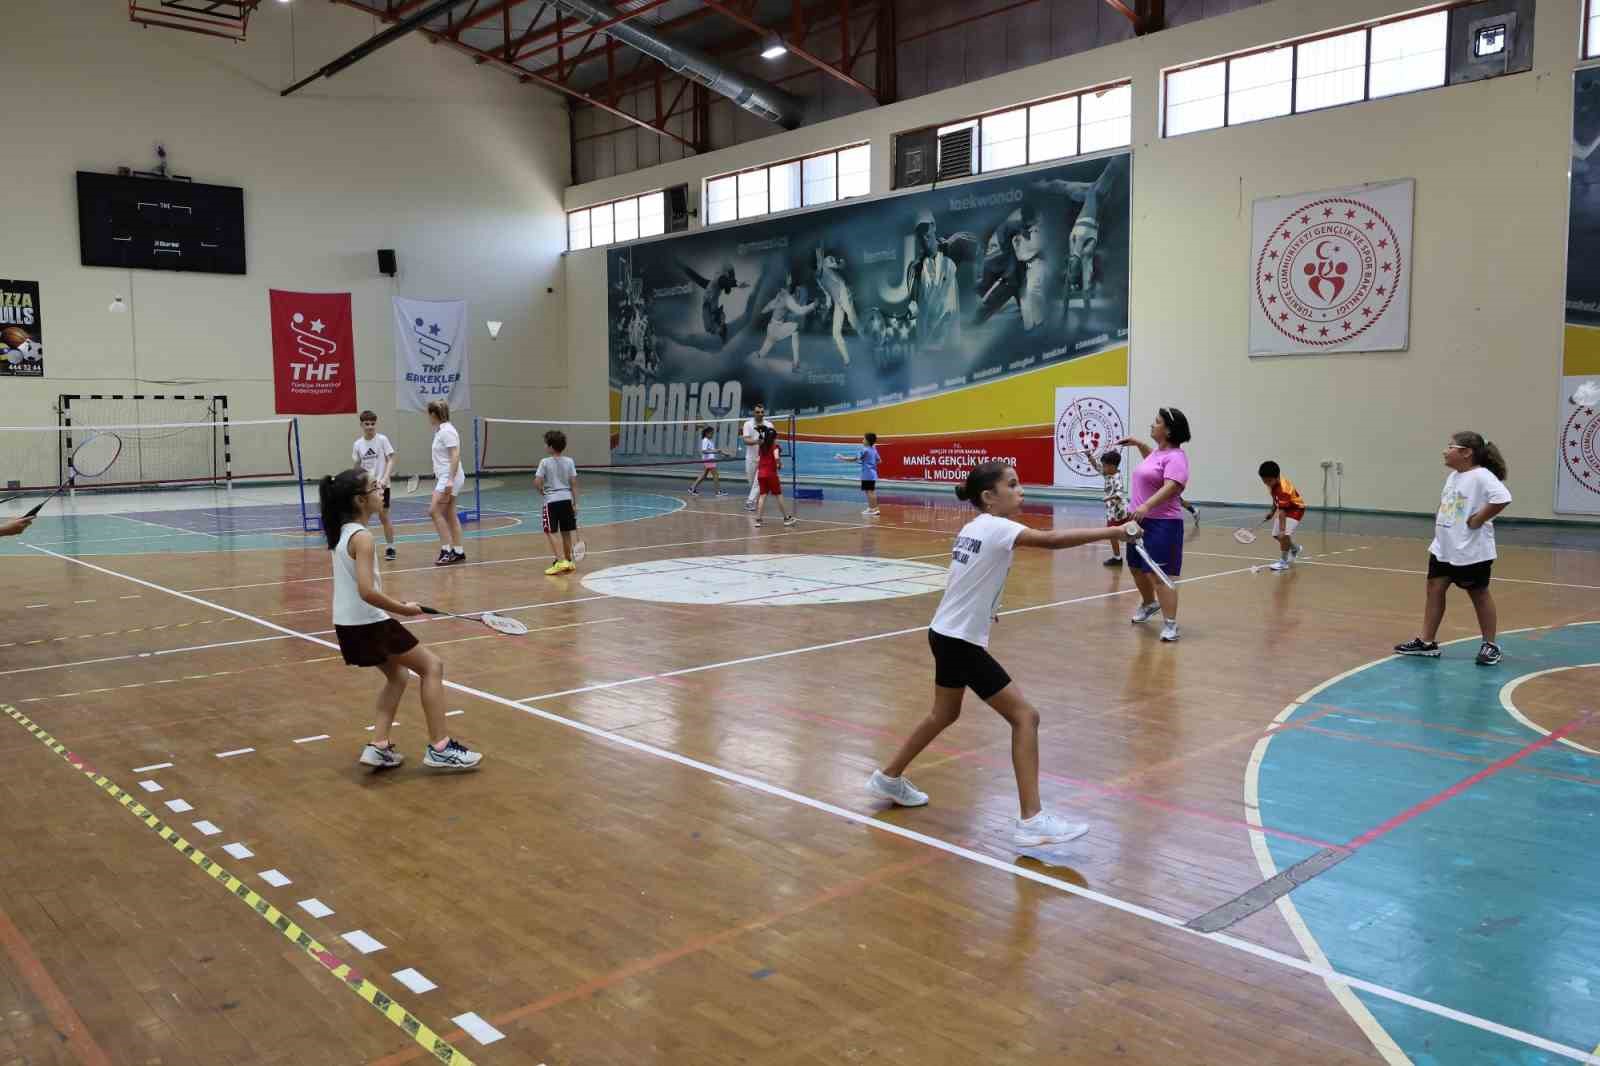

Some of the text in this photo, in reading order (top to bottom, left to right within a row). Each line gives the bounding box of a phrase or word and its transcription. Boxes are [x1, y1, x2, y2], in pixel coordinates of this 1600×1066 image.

[289, 362, 340, 381] THF
[422, 364, 445, 373] THF
[903, 454, 937, 466] MANİSA
[938, 454, 977, 468] GENÇLİK
[924, 468, 933, 480] İL
